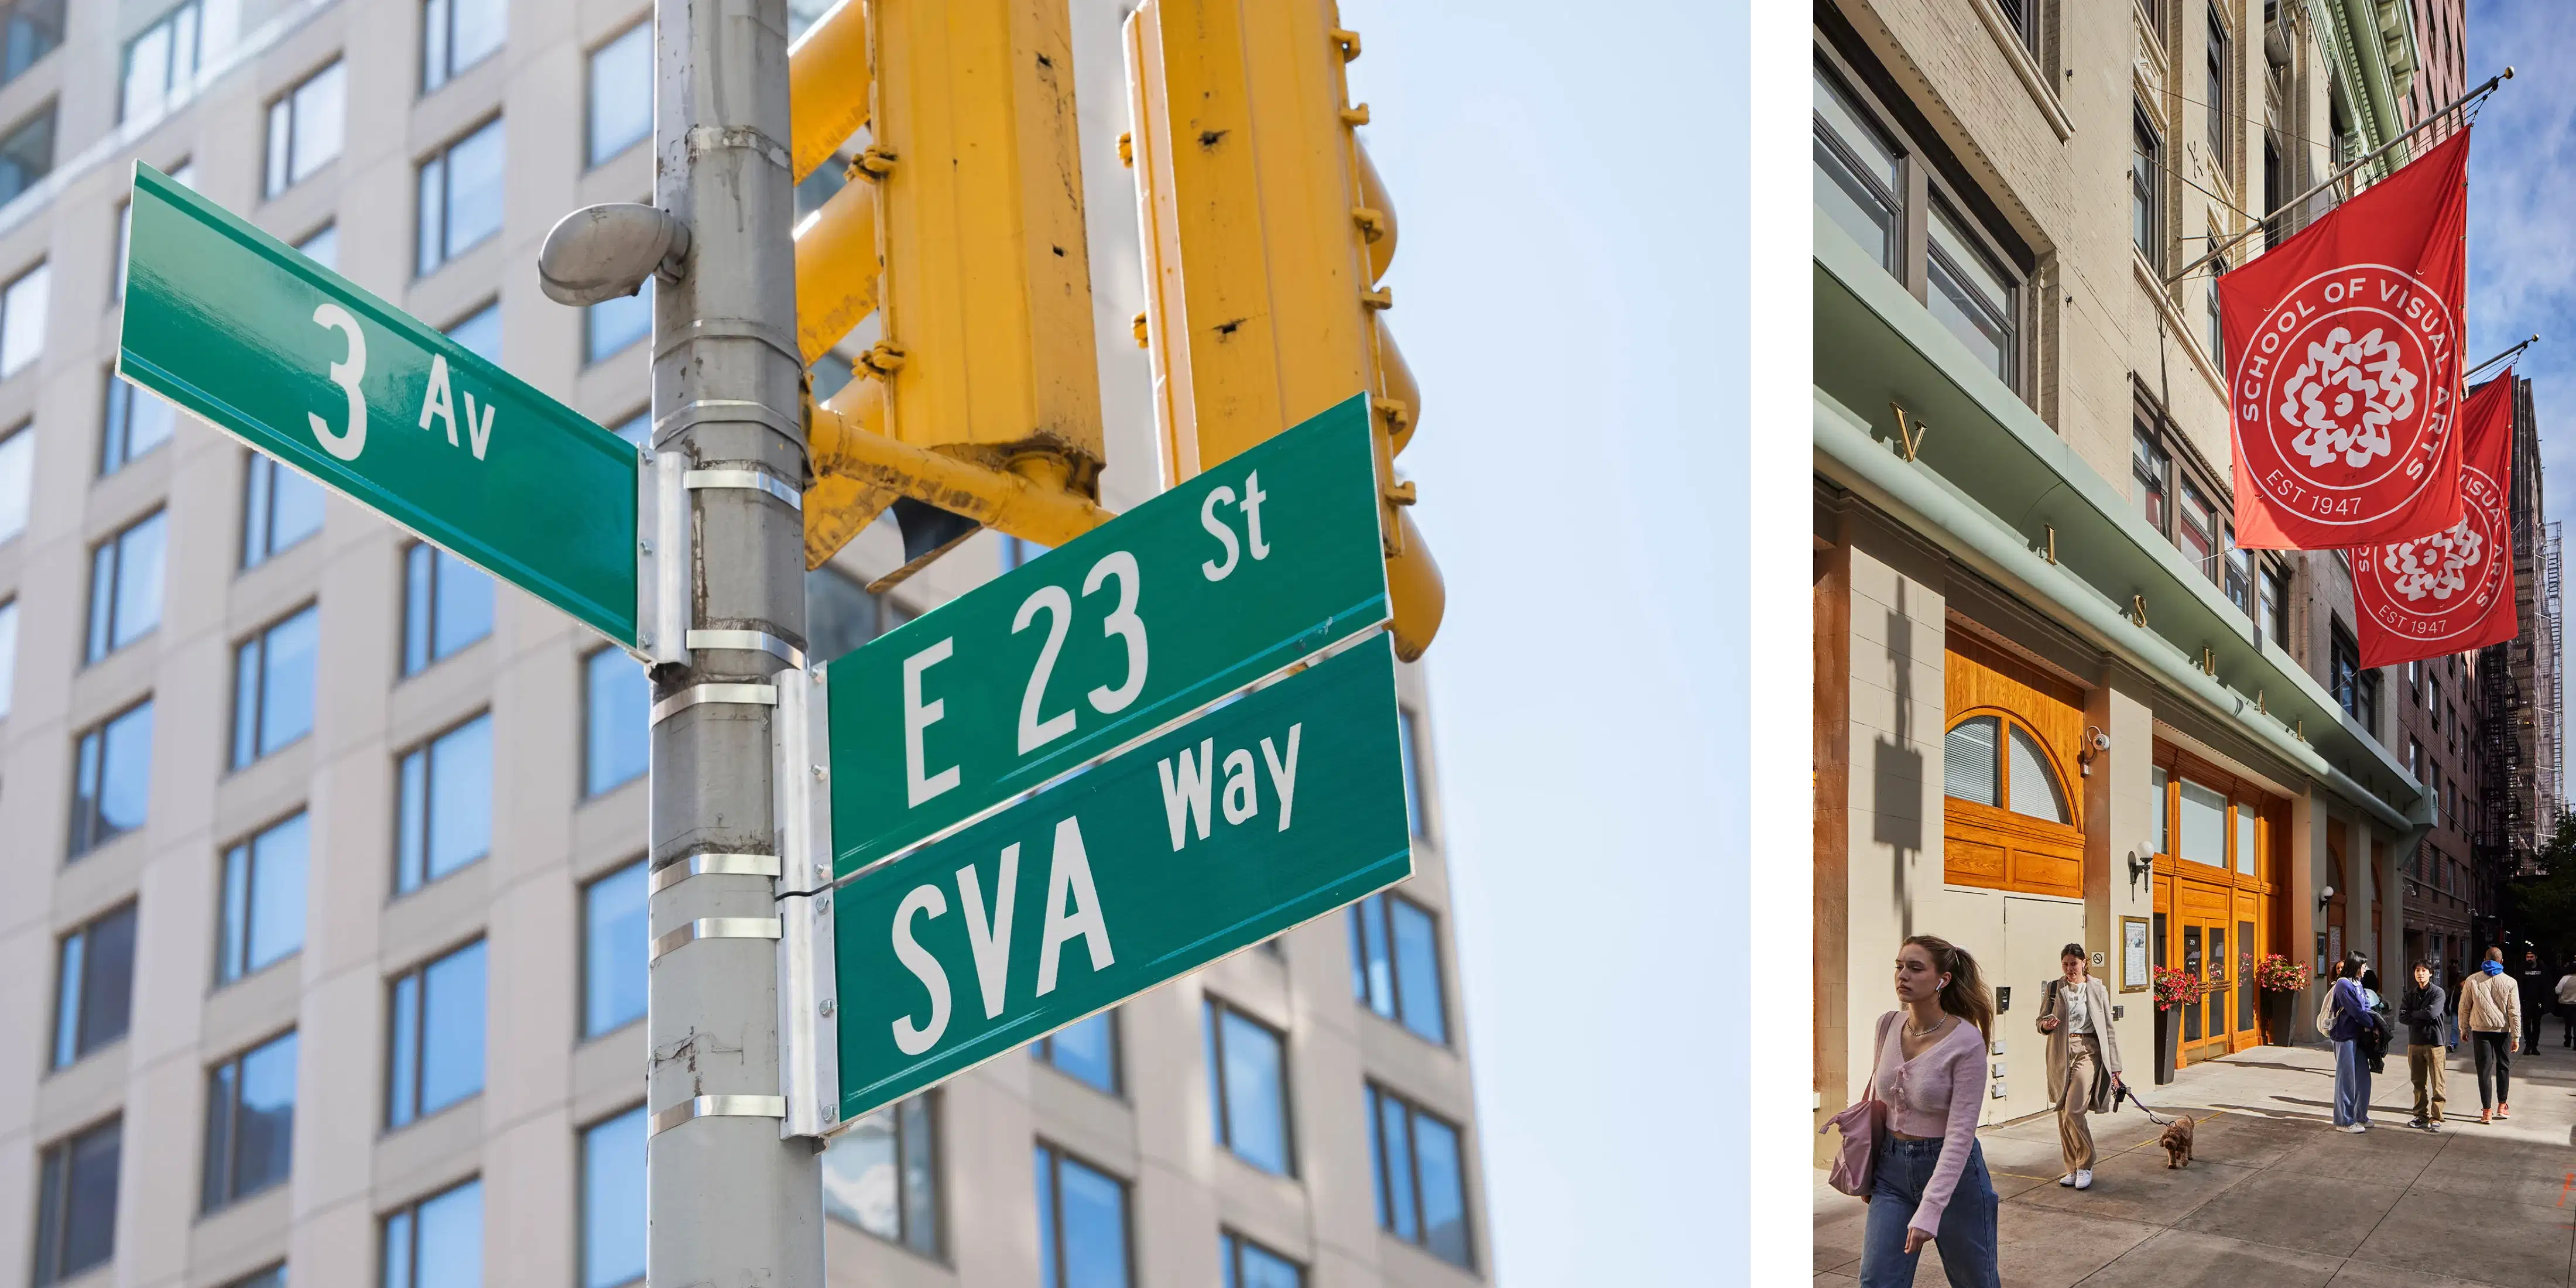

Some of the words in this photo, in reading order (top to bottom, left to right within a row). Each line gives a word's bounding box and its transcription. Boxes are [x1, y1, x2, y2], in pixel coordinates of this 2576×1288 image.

[2325, 278, 2366, 303] OF
[2380, 279, 2450, 375] VISUAL
[309, 302, 368, 461] 3
[419, 354, 495, 461] Av
[2243, 300, 2316, 422] SCHOOL
[2406, 386, 2450, 481] ARTS
[2266, 469, 2306, 503] EST
[2312, 496, 2362, 515] 1947
[2379, 604, 2407, 628] EST
[2411, 621, 2447, 633] 1947
[2476, 544, 2503, 608] ARTS
[904, 636, 960, 809] E
[1012, 551, 1148, 756] 23
[1201, 470, 1270, 581] St
[892, 815, 1115, 1056] SVA
[1157, 722, 1301, 852] Way
